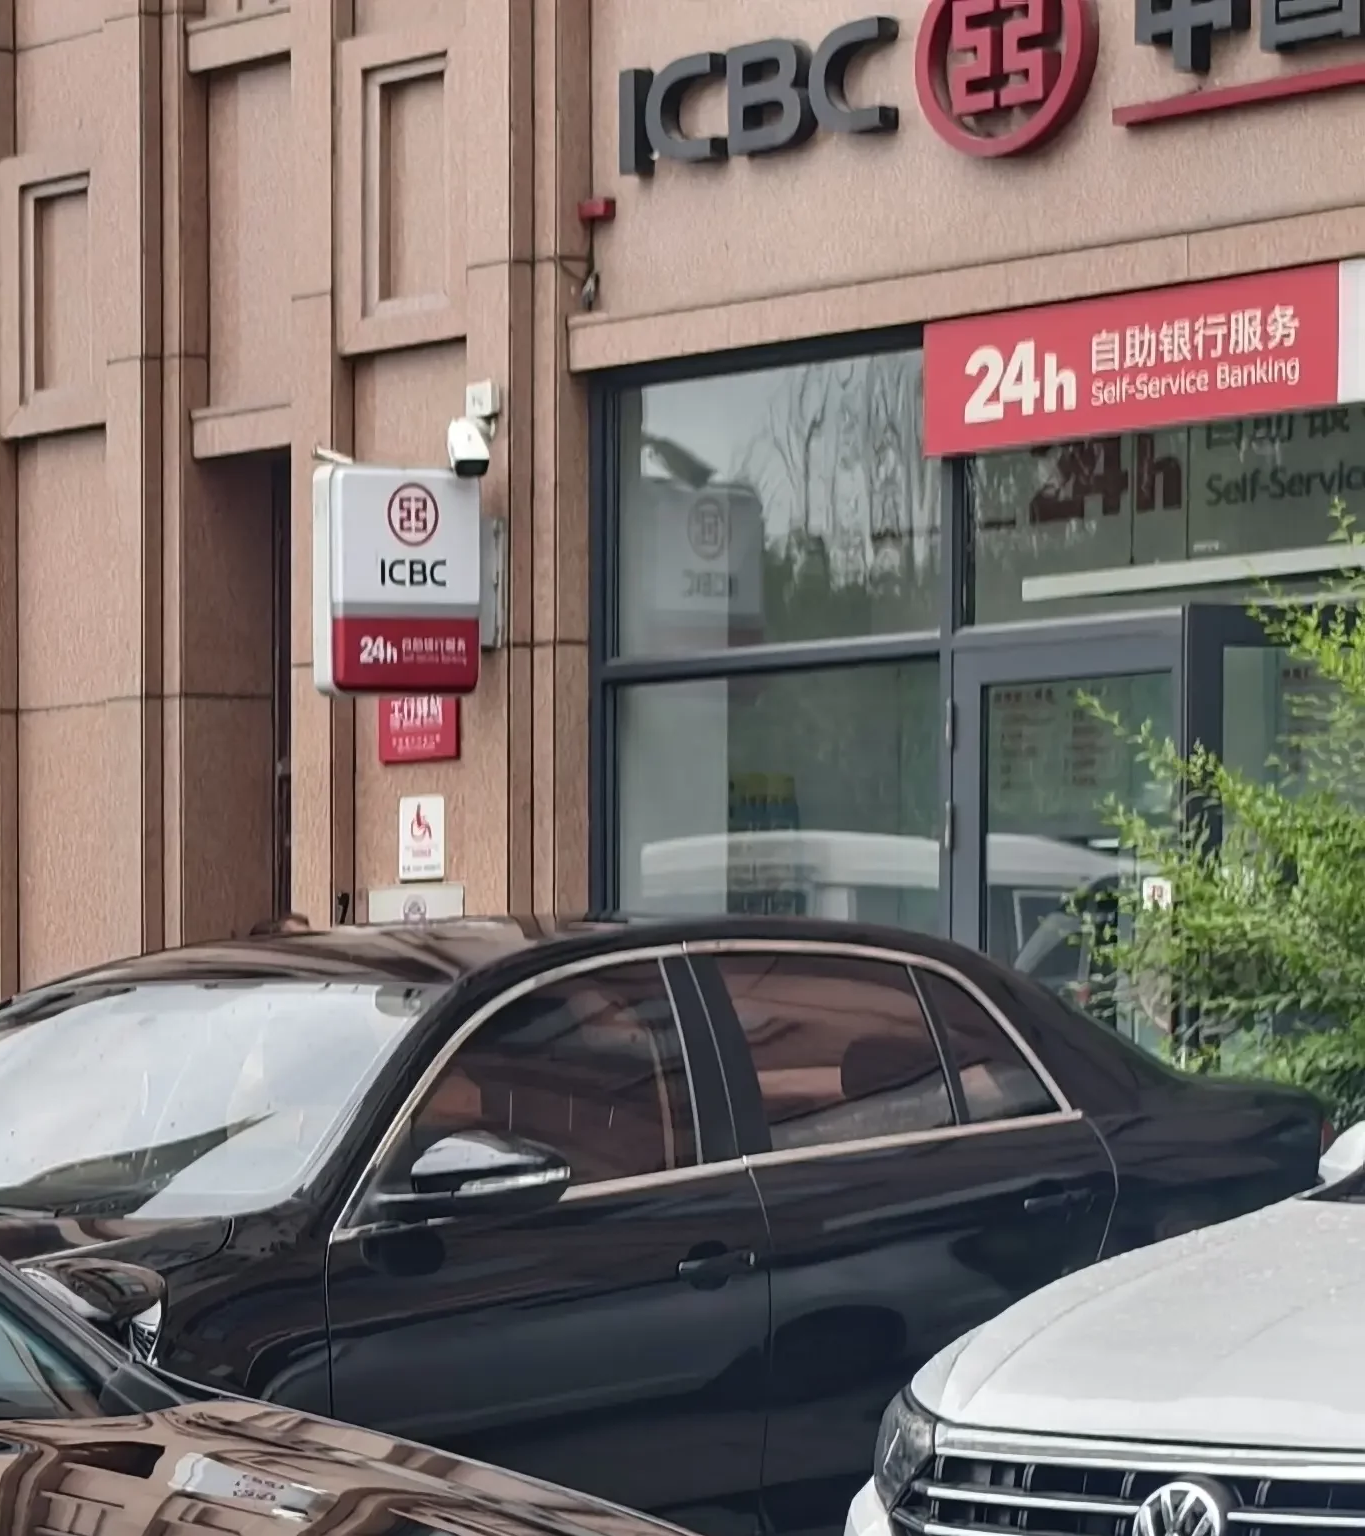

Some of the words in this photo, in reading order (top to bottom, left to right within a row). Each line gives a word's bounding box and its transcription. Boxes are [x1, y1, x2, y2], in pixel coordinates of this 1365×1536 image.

[620, 16, 899, 175] ICBC
[1090, 305, 1300, 374] 自助银行服务
[964, 340, 1077, 424] 24h
[1090, 368, 1210, 408] Self-Service
[1215, 356, 1301, 391] Banking
[381, 558, 447, 587] ICBC
[360, 636, 398, 664] 24h
